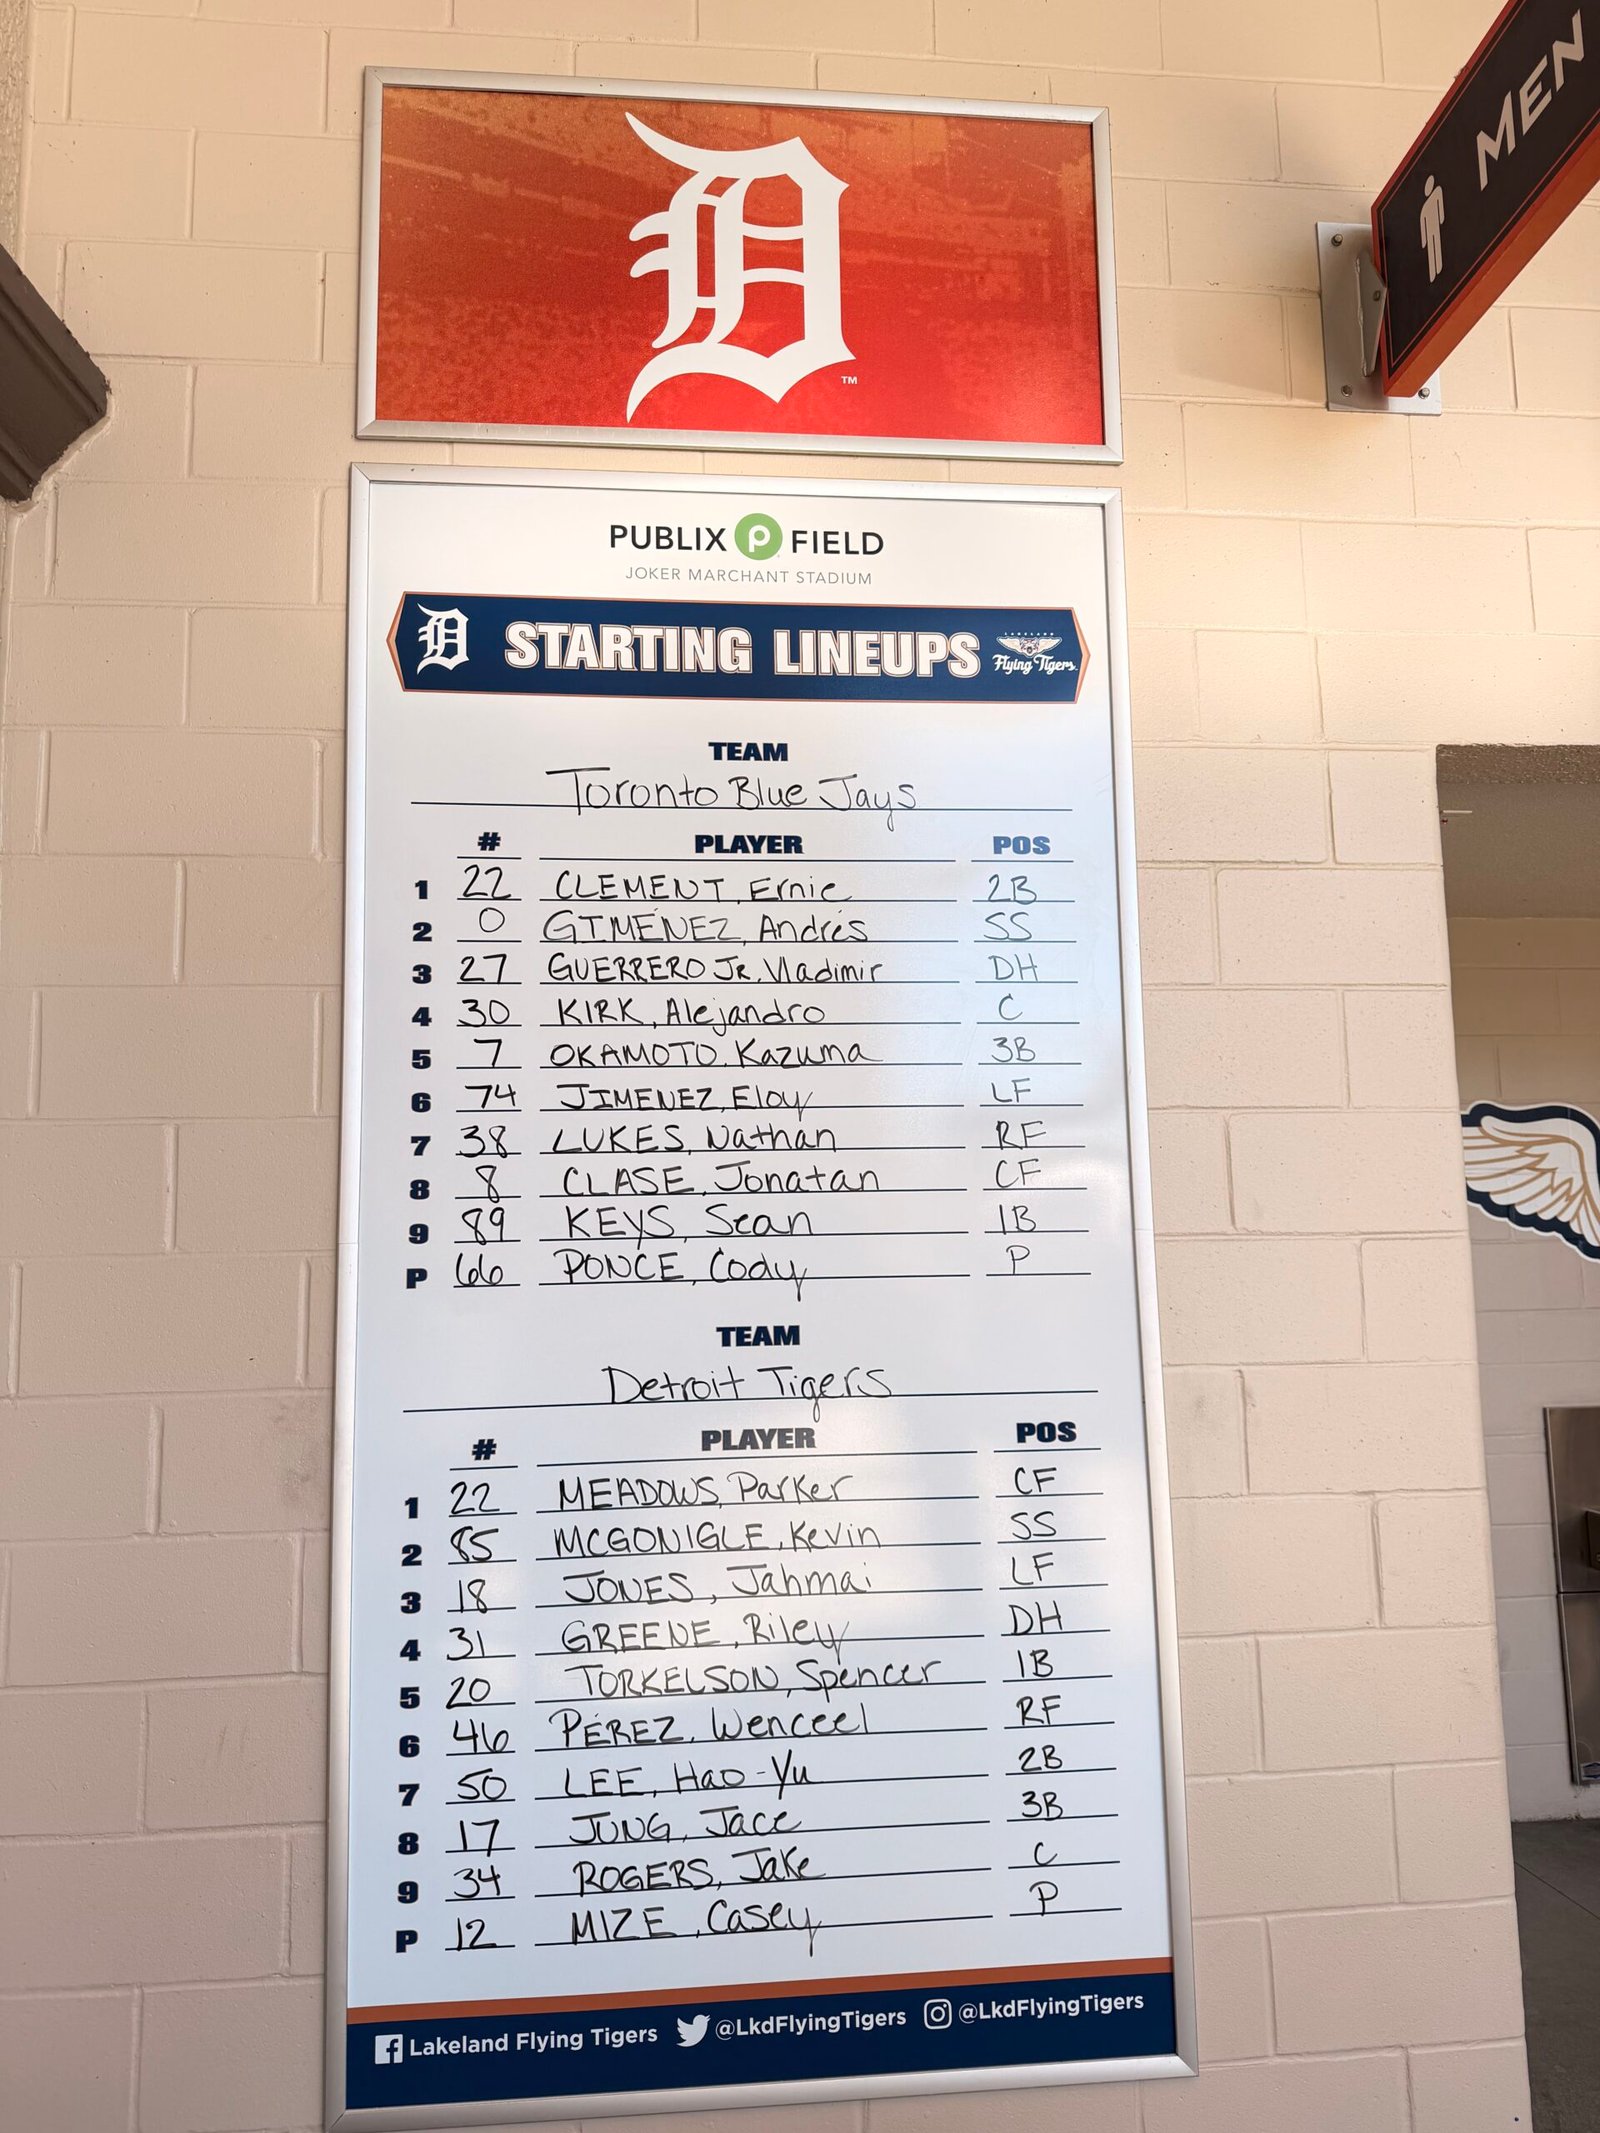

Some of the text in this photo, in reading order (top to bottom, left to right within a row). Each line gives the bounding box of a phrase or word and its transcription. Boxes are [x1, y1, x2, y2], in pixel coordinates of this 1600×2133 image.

[1476, 8, 1585, 192] MEN
[610, 524, 727, 551] PUBLIX
[792, 529, 884, 555] FIELD
[625, 567, 872, 585] JOKER MARCHANT STADIUM
[504, 620, 982, 680] STARTING LINEUPS
[992, 653, 1076, 675] Flying Tigers
[708, 741, 789, 762] TEAM
[546, 766, 918, 832] Toronto Blue Jays
[477, 832, 1051, 856] # PLAYER POS
[413, 879, 431, 900] 1
[463, 864, 1037, 905] 22 CLEMENT, Ernie 2B
[411, 922, 433, 942] 2
[478, 907, 505, 933] 0
[983, 912, 1032, 941] SS
[411, 964, 433, 984] 3
[460, 953, 507, 984] 27
[548, 953, 705, 983] GUERRERO
[764, 956, 883, 982] Vladimir
[988, 953, 1038, 982] DH
[411, 1006, 433, 1027] 4
[458, 993, 1023, 1036] 30 KIRK, Alejandro C
[411, 1049, 431, 1069] 5
[473, 1038, 503, 1067] 7
[736, 1038, 883, 1068] Kazuma
[991, 1036, 1036, 1063] 3B
[410, 1092, 431, 1113] 6
[464, 1084, 517, 1109] 74
[733, 1085, 813, 1121] Eloy
[991, 1078, 1031, 1102] LF
[410, 1135, 431, 1156] 7
[459, 1120, 1046, 1158] 38 LUKES, Nathan RF
[409, 1179, 430, 1199] 8
[475, 1164, 499, 1203] 8
[715, 1160, 879, 1192] Jonatan
[995, 1158, 1041, 1189] CF
[408, 1223, 430, 1244] 9
[461, 1206, 505, 1245] 89
[706, 1203, 813, 1236] Sean
[998, 1204, 1037, 1234] 1B
[406, 1267, 428, 1289] P
[455, 1245, 1030, 1302] 66 PONCE, Cody P
[716, 1325, 800, 1347] TEAM
[601, 1365, 893, 1422] Detroit Tigers
[472, 1421, 1077, 1460] # PLAYER POS
[450, 1482, 500, 1515] 22
[727, 1471, 853, 1504] Parker
[1014, 1467, 1056, 1494] CF
[404, 1497, 420, 1519] 1
[451, 1525, 499, 1563] 85
[791, 1520, 881, 1553] Kevin
[1010, 1511, 1056, 1540] SS
[401, 1544, 422, 1566] 2
[457, 1552, 1053, 1614] 18 JONES, Jahmai LF
[400, 1592, 421, 1614] 3
[447, 1600, 1062, 1665] 31 GREENE, Riley DH
[400, 1640, 421, 1662] 4
[446, 1677, 491, 1710] 20
[796, 1659, 941, 1702] Spencer
[1018, 1649, 1054, 1679] 1B
[400, 1687, 420, 1710] 5
[453, 1720, 509, 1754] 46
[712, 1702, 868, 1741] Wenceel
[1016, 1695, 1060, 1726] RF
[399, 1735, 420, 1758] 6
[457, 1768, 507, 1801] 50
[565, 1767, 657, 1798] LEE,
[1019, 1745, 1062, 1773] 2B
[399, 1784, 420, 1806] 7
[459, 1791, 1063, 1857] 17 JUNG, Jace 3B
[397, 1832, 418, 1855] 8
[454, 1866, 500, 1899] 34
[573, 1860, 722, 1897] ROGERS,
[1034, 1842, 1057, 1866] C
[397, 1881, 418, 1904] 9
[456, 1918, 497, 1950] 12
[707, 1899, 822, 1957] Casey
[1029, 1881, 1059, 1916] P
[396, 1930, 418, 1953] P
[958, 1993, 1144, 2025] @LkdFlyingTigers
[410, 2032, 509, 2057] Lakeland
[516, 2029, 583, 2054] Flying
[591, 2025, 658, 2049] Tigers
[715, 2010, 907, 2042] @LkdFlyingTigers
